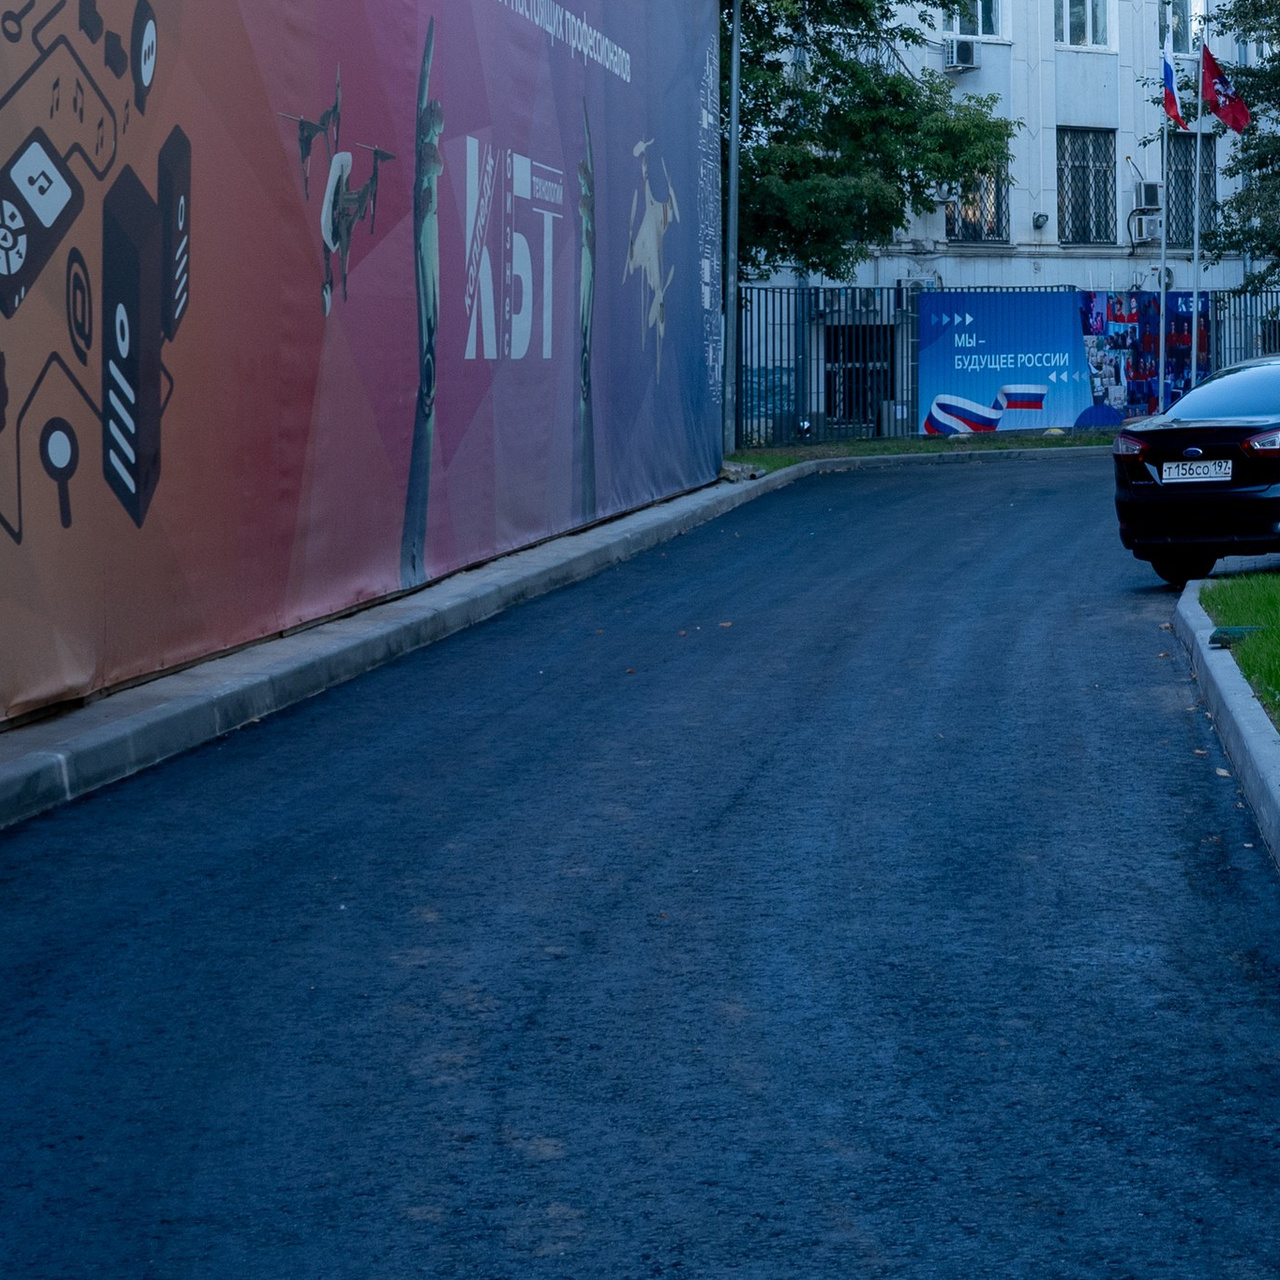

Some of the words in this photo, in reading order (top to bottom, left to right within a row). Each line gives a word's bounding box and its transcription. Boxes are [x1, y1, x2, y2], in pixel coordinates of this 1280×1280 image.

[565, 10, 631, 83] профессионалов
[954, 333, 976, 347] МЫ
[954, 354, 1015, 372] БУДУЩЕЕ
[1017, 352, 1069, 368] РОССИИ
